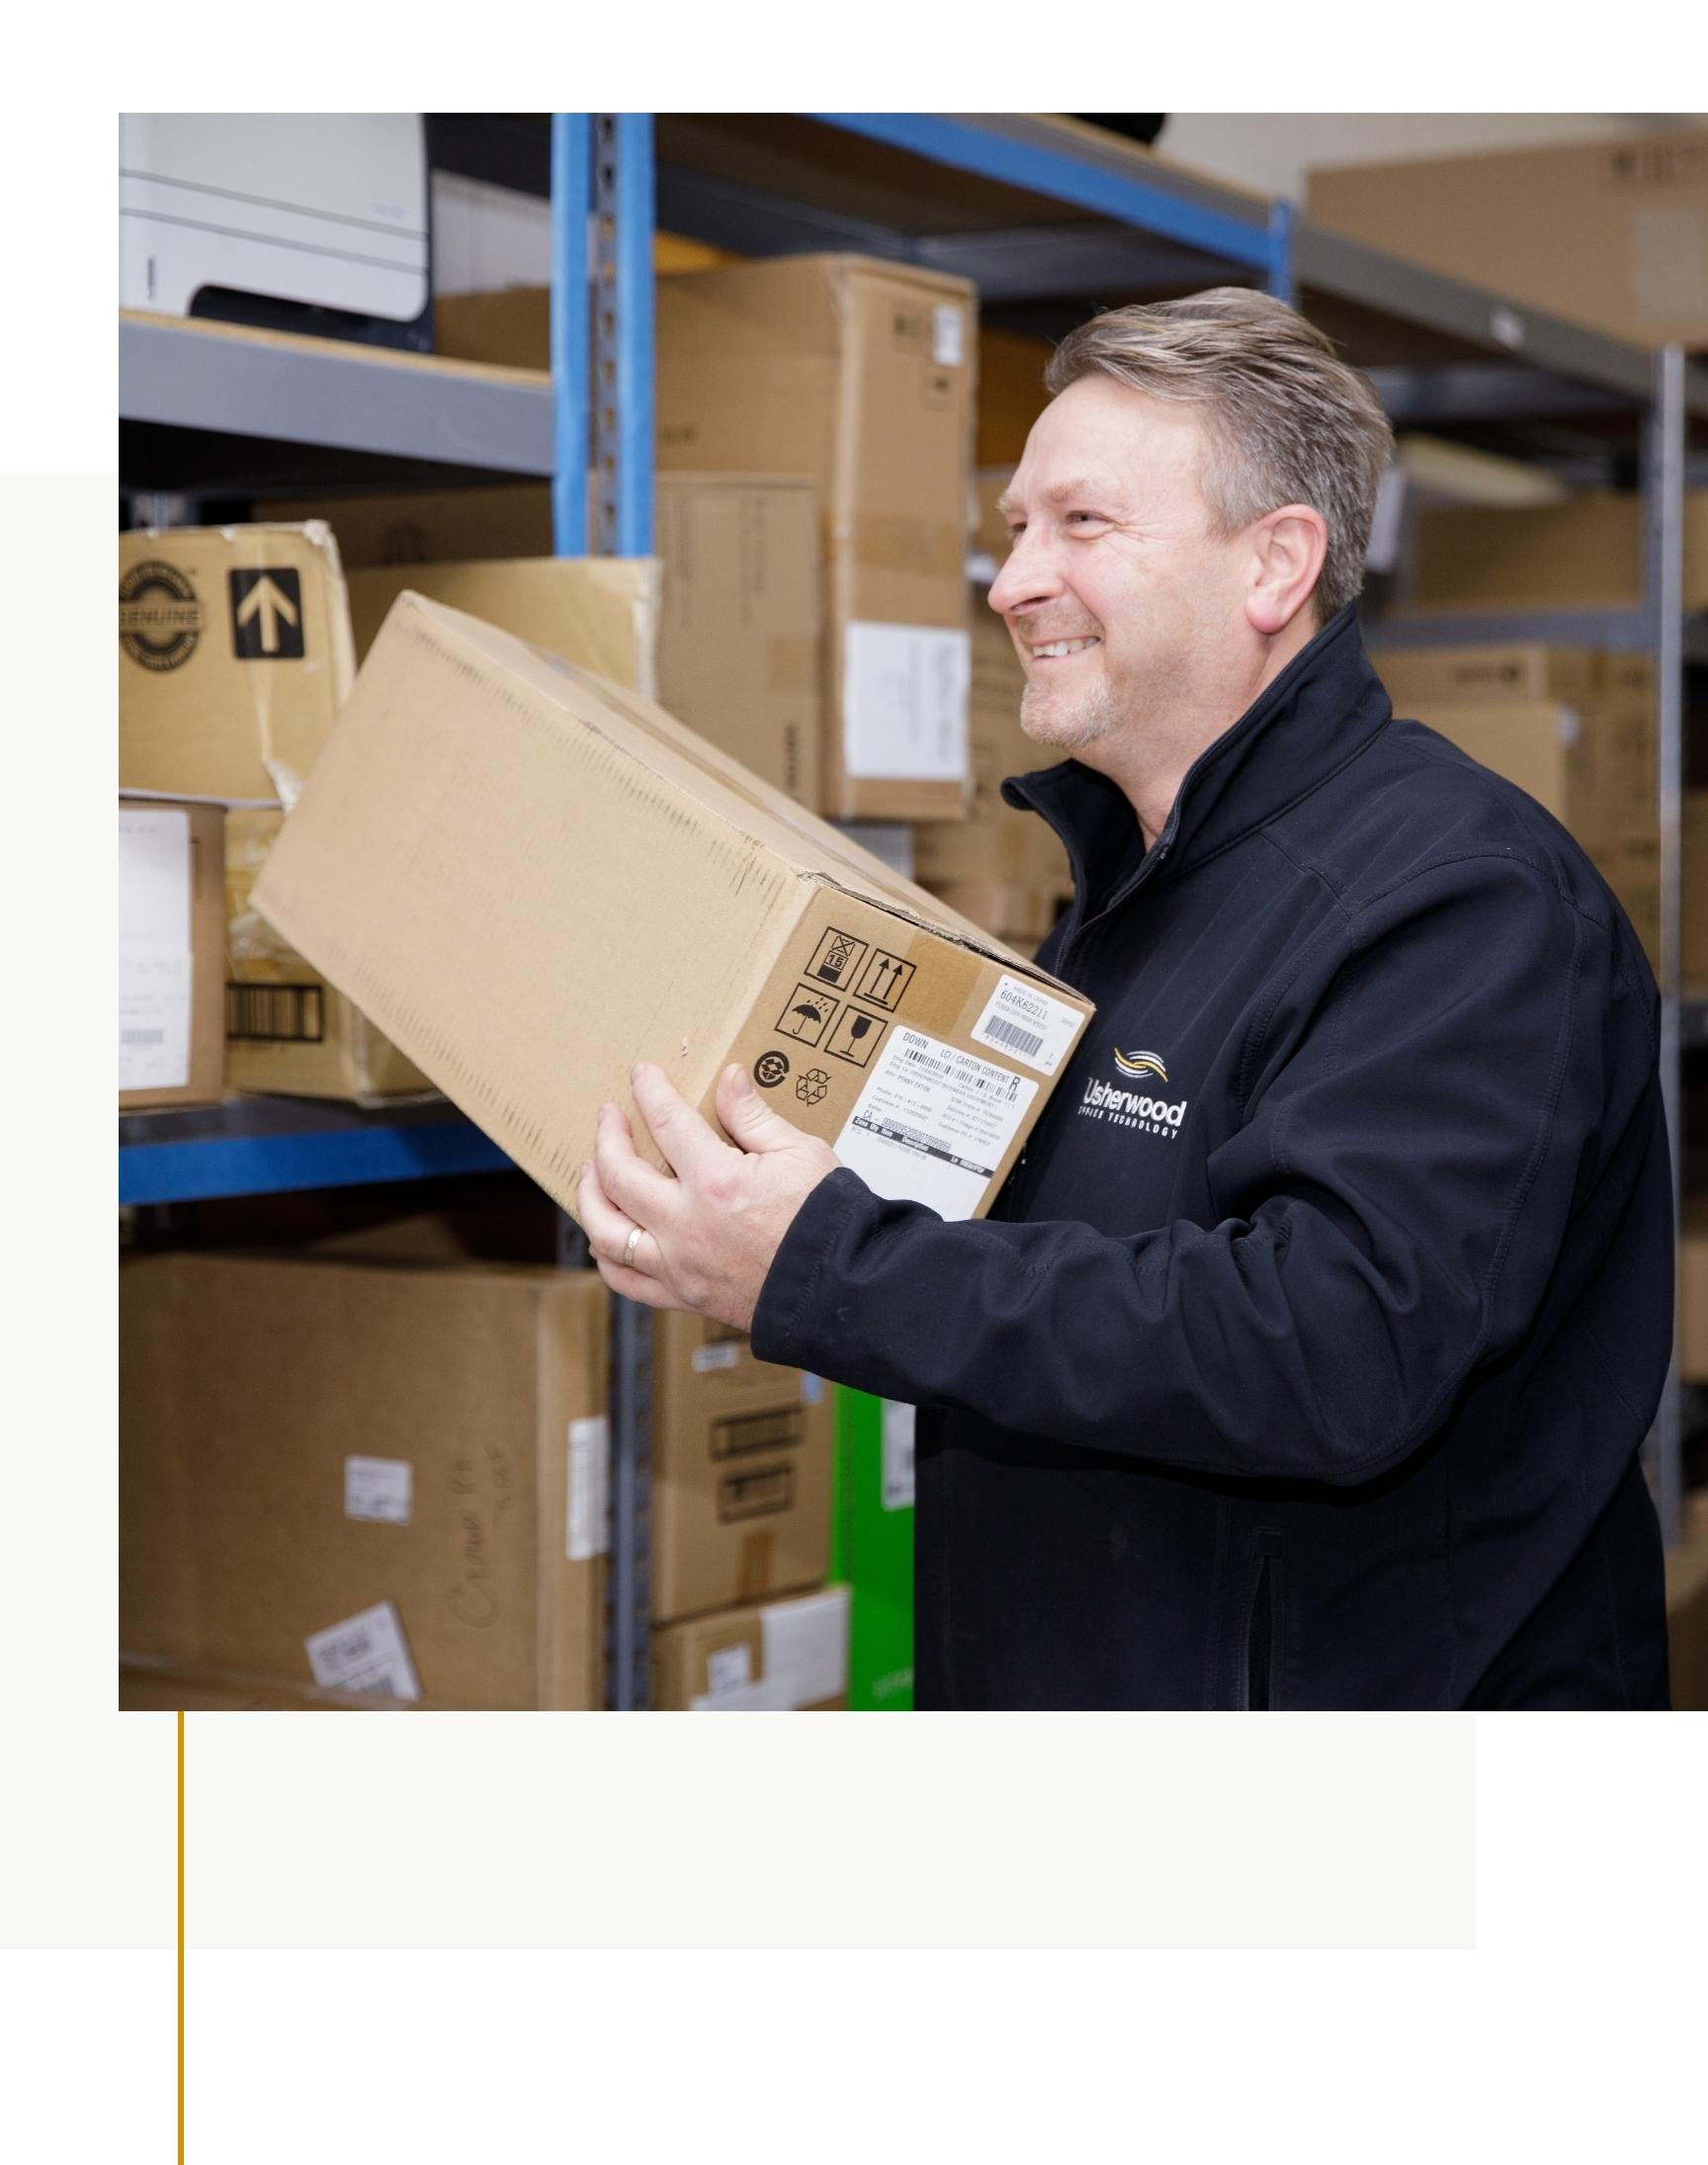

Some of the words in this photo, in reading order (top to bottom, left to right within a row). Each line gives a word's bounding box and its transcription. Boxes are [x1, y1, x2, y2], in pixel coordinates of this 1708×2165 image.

[829, 954, 844, 968] 15
[902, 1032, 929, 1049] DOWN
[956, 1056, 982, 1072] CARTON
[982, 1067, 1010, 1083] CONTENT
[1009, 1077, 1021, 1091] R
[1083, 1077, 1187, 1126] Usherwood
[1107, 1112, 1178, 1139] TECHNOLOGY
